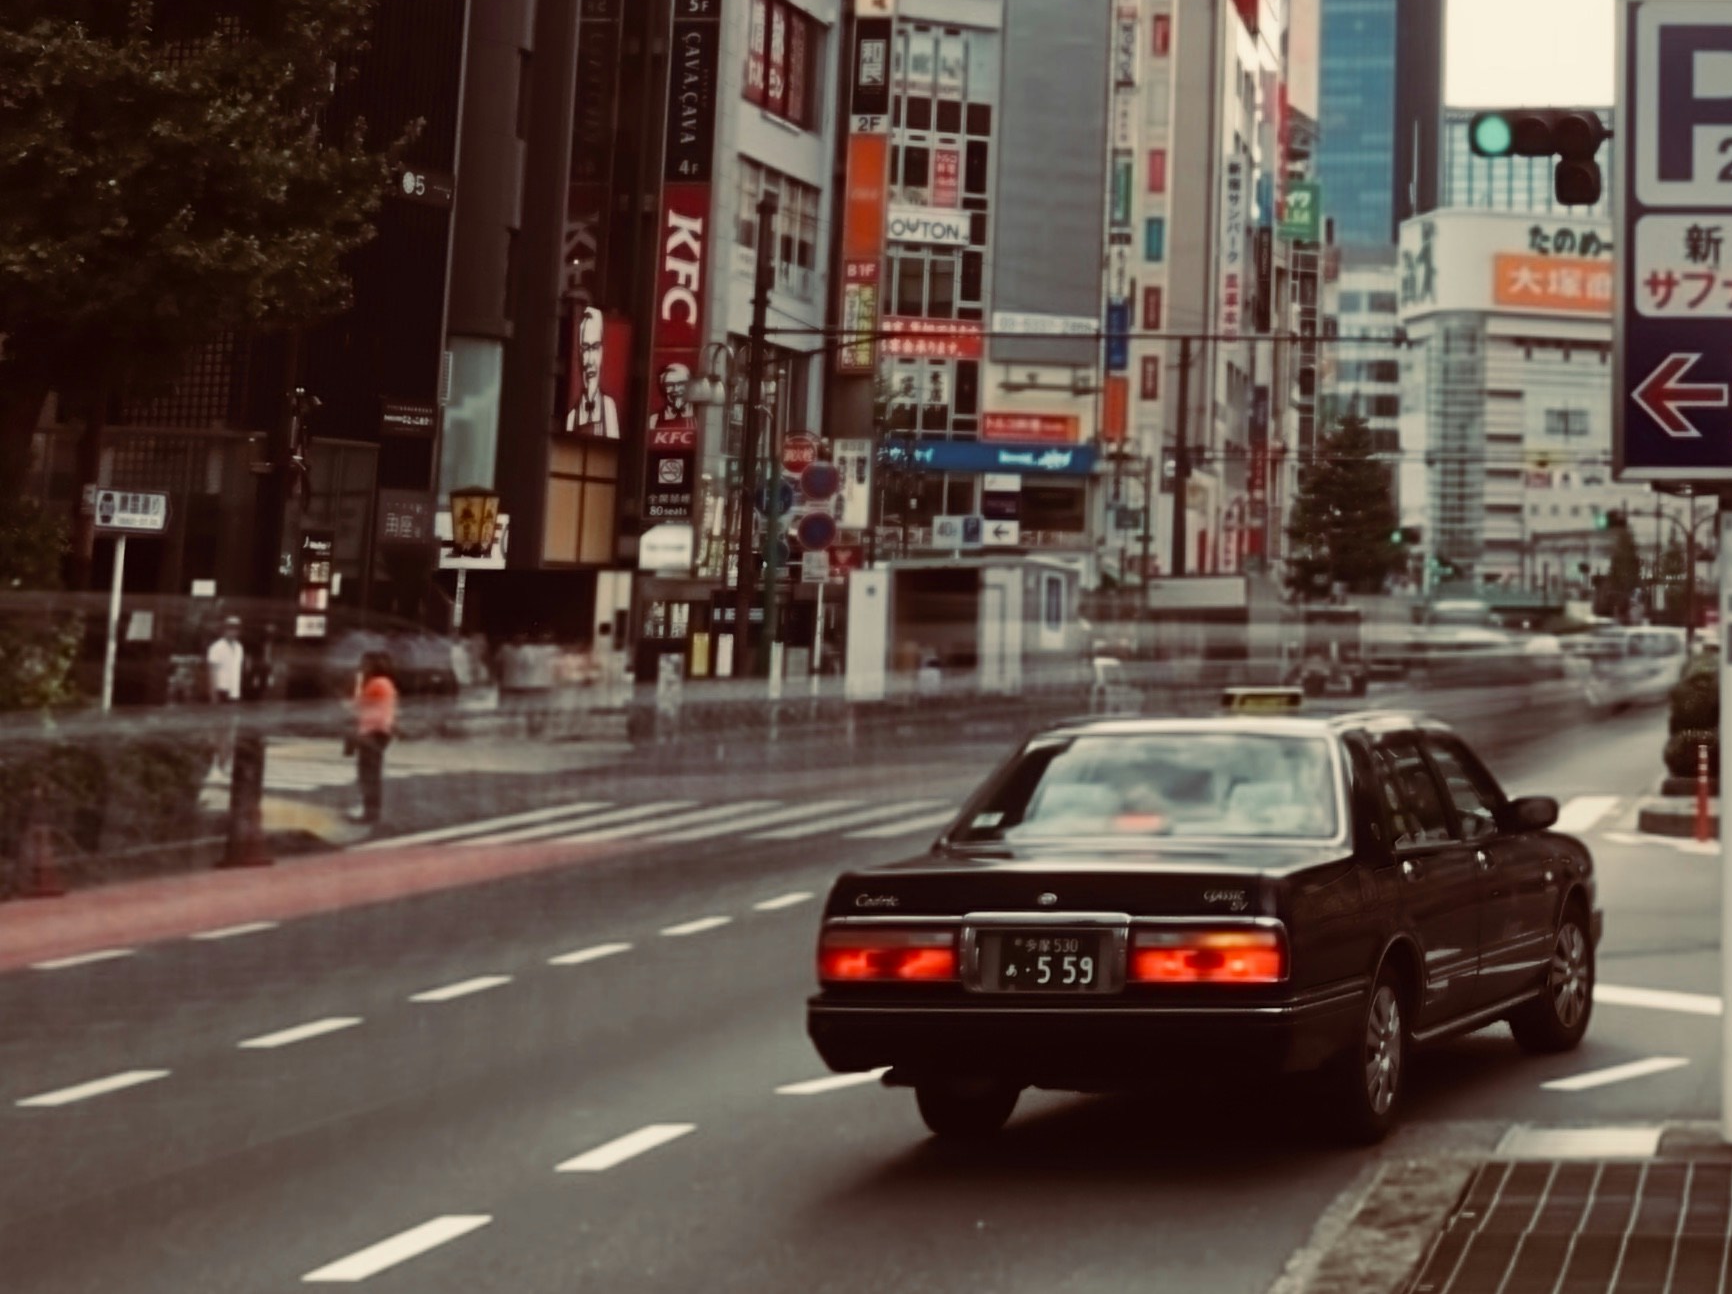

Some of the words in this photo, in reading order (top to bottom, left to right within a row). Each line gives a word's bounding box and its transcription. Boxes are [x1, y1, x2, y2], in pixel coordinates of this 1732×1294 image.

[857, 116, 882, 132] 2F
[679, 158, 700, 176] 4F
[661, 209, 703, 330] KFC
[653, 431, 695, 446] KFC
[1054, 938, 1079, 953] 530
